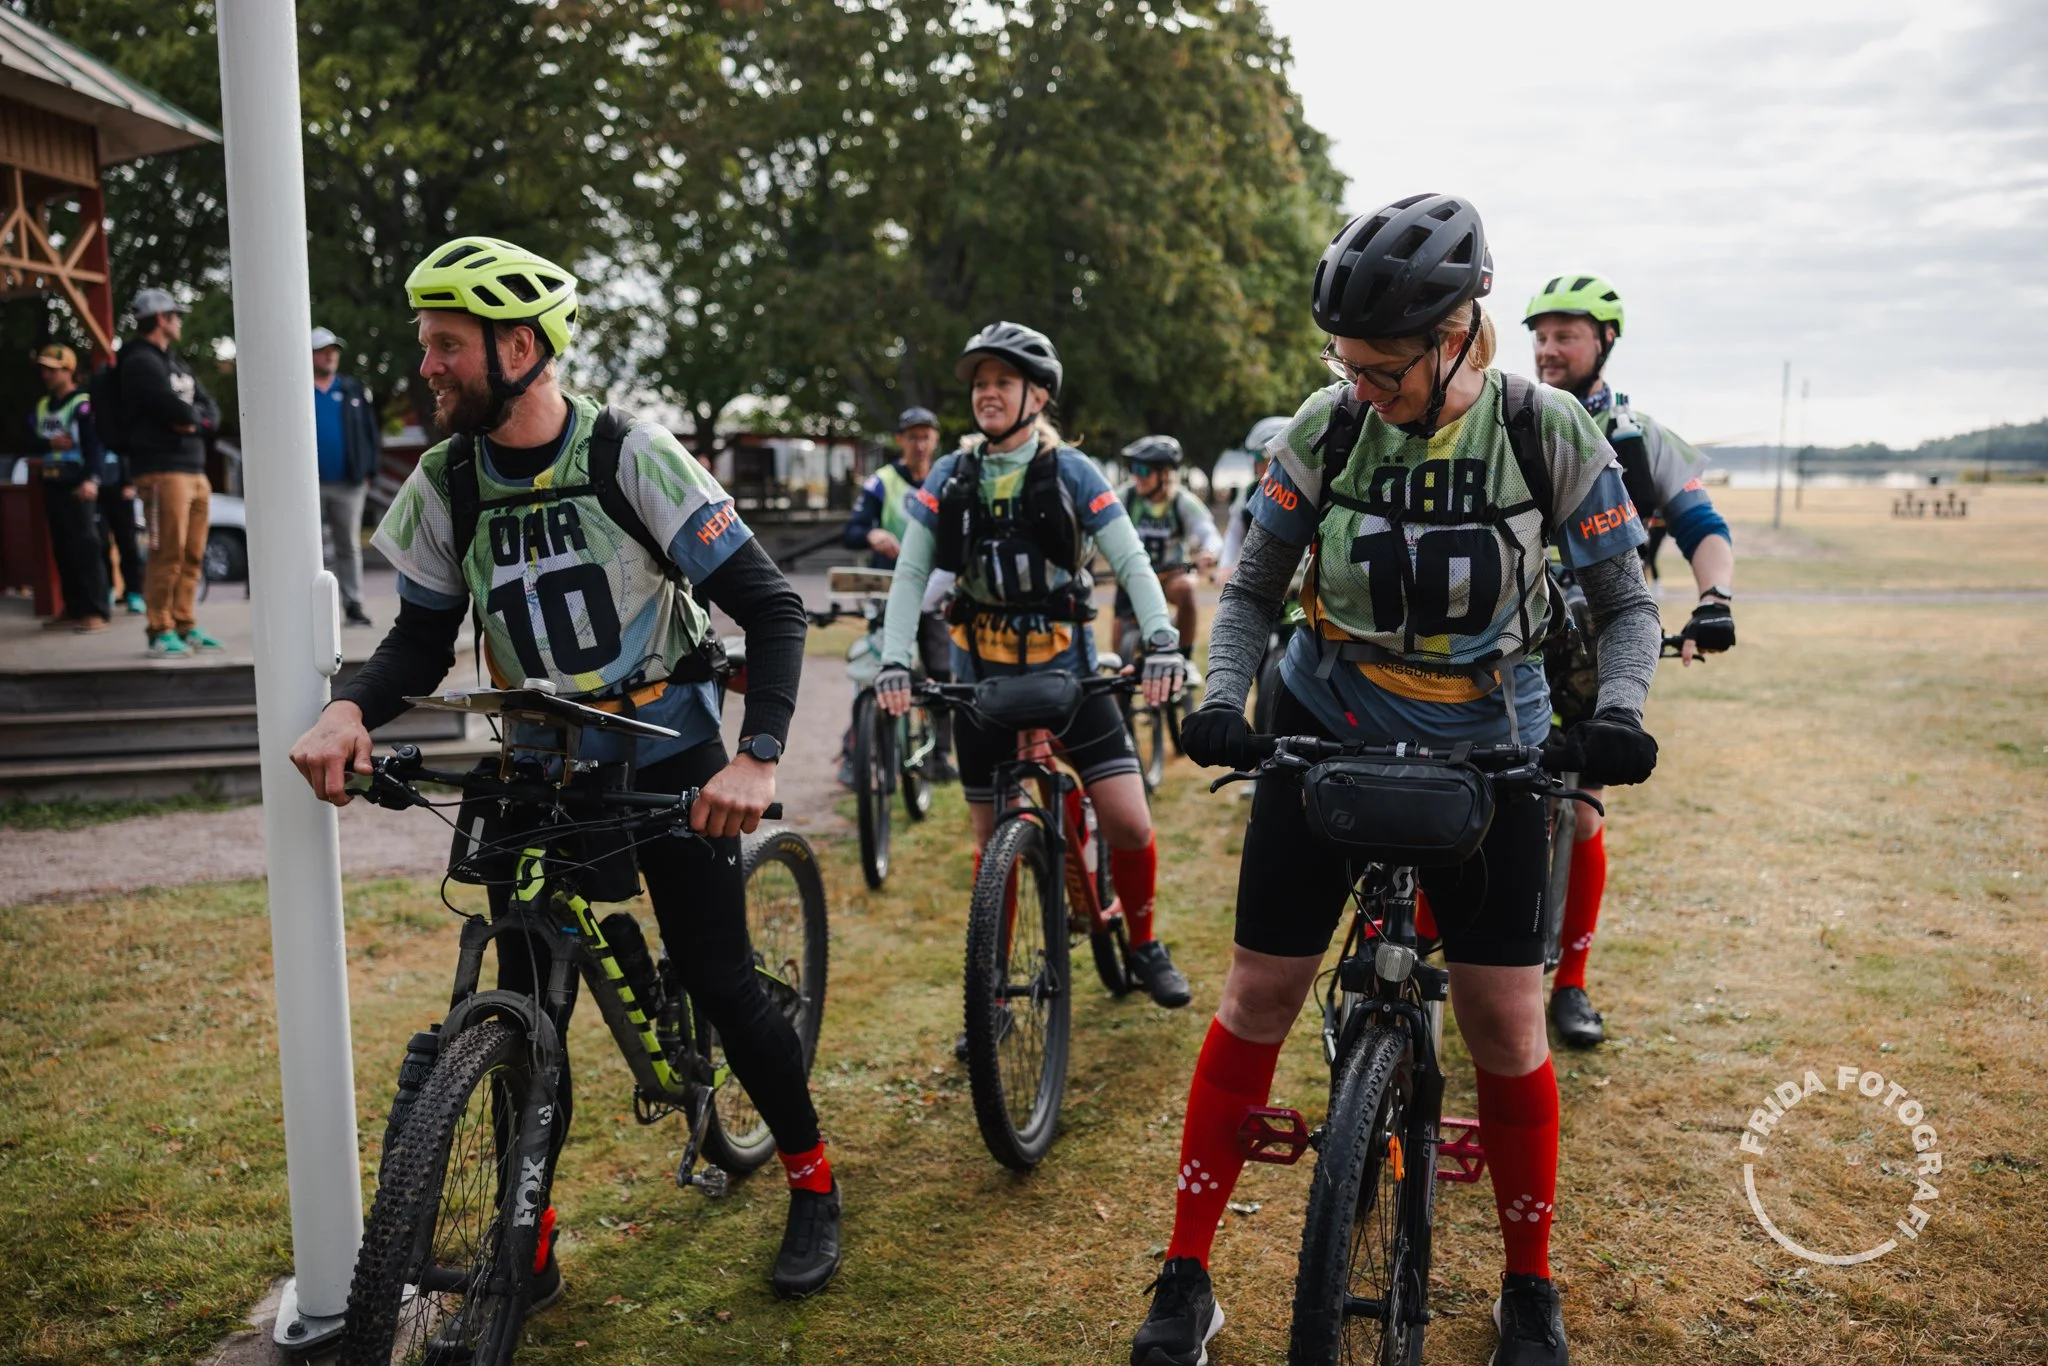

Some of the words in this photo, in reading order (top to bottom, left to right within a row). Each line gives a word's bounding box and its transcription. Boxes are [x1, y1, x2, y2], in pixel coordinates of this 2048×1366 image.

[1368, 456, 1487, 521] ÖAR
[489, 502, 587, 566] ÖAR
[1351, 530, 1500, 636] 10
[487, 562, 622, 680] 10
[1533, 891, 1542, 933] ENDURANCE
[512, 1156, 547, 1227] FOX
